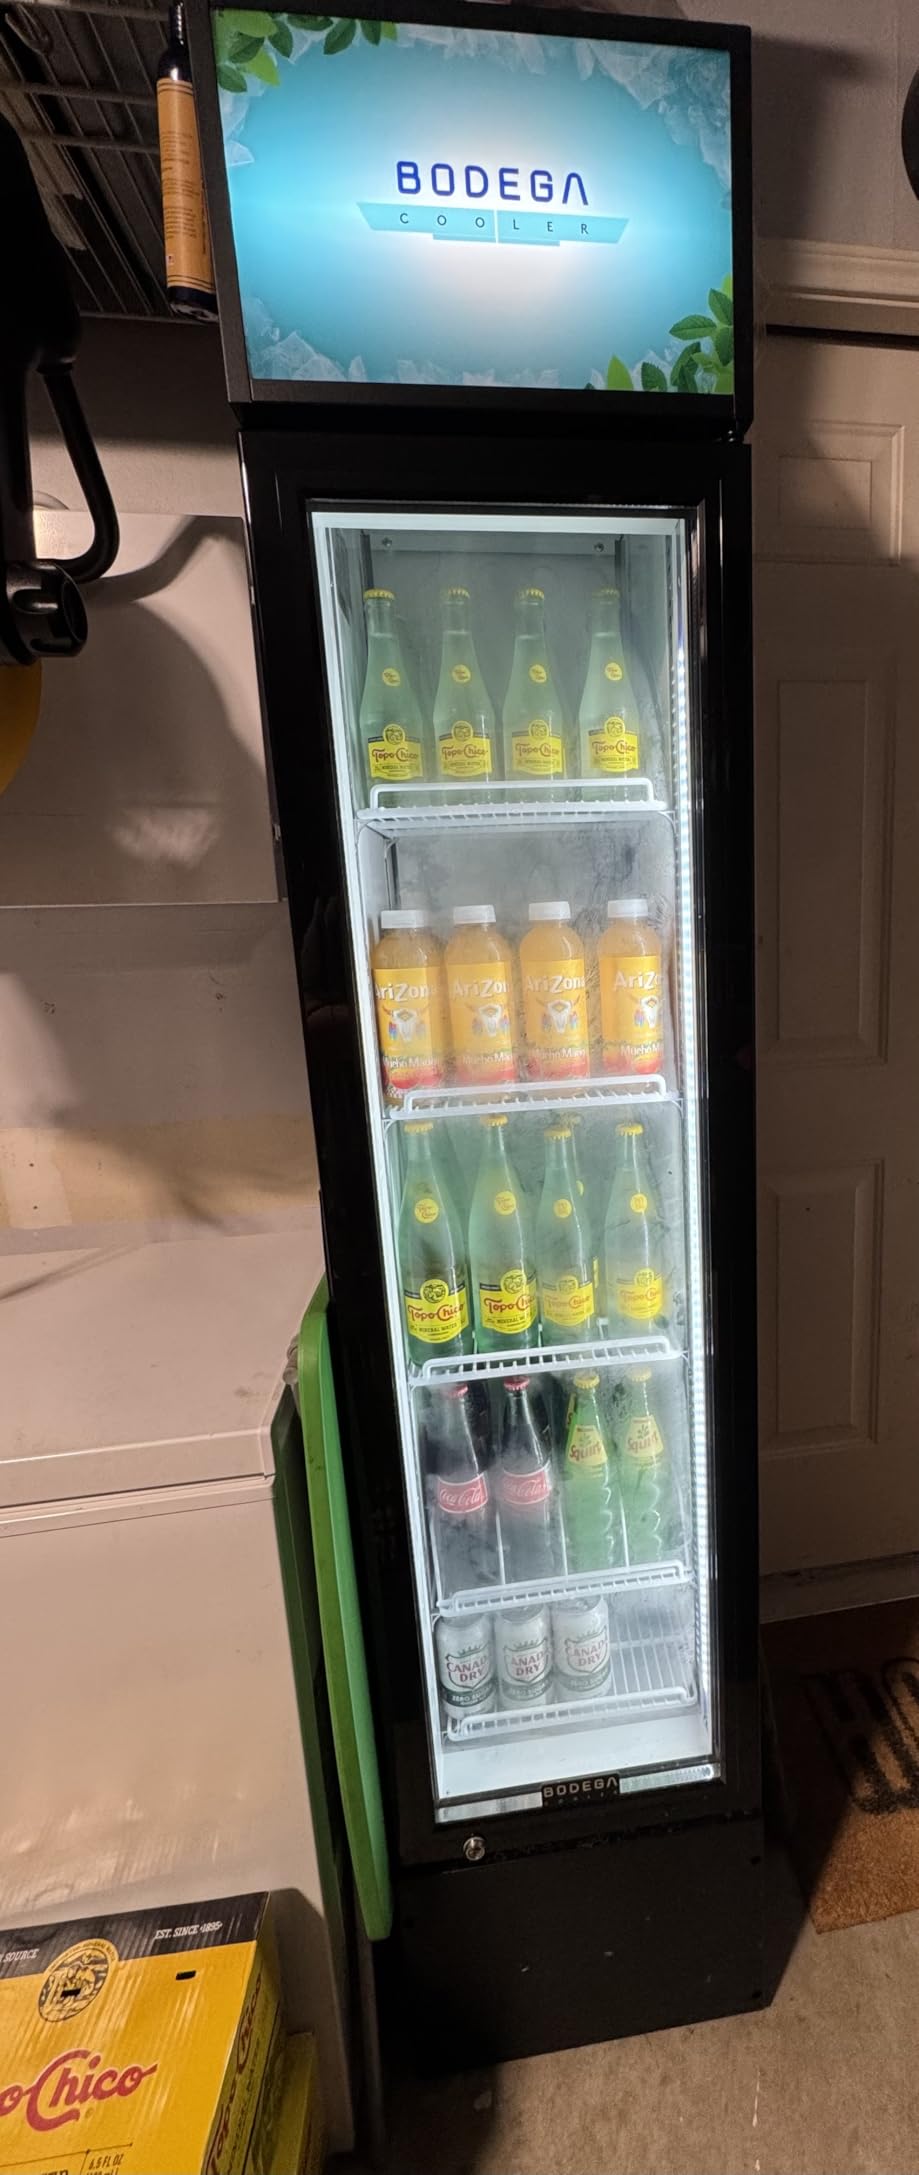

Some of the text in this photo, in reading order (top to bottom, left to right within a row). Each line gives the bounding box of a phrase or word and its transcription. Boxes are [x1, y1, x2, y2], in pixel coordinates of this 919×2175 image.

[396, 161, 589, 206] BODEGA
[400, 212, 590, 235] COOLER
[371, 748, 395, 762] Topo
[375, 982, 434, 1002] riZon
[453, 977, 510, 998] AriZon
[408, 1303, 465, 1322] Topo Chico
[484, 1297, 514, 1314] Topo
[570, 1441, 601, 1461] Squirt
[627, 1430, 659, 1454] Squirt
[446, 1655, 487, 1673] CANAD
[577, 1653, 600, 1667] DRY
[460, 1668, 485, 1682] DRY
[515, 1663, 540, 1677] DRY
[543, 1776, 618, 1798] BODEGA
[155, 1928, 172, 1940] EST.
[172, 1924, 200, 1938] SINCE
[4, 1948, 40, 1962] SOURCE
[25, 2048, 158, 2133] Chico
[102, 2155, 111, 2168] FL
[112, 2153, 124, 2167] OZ
